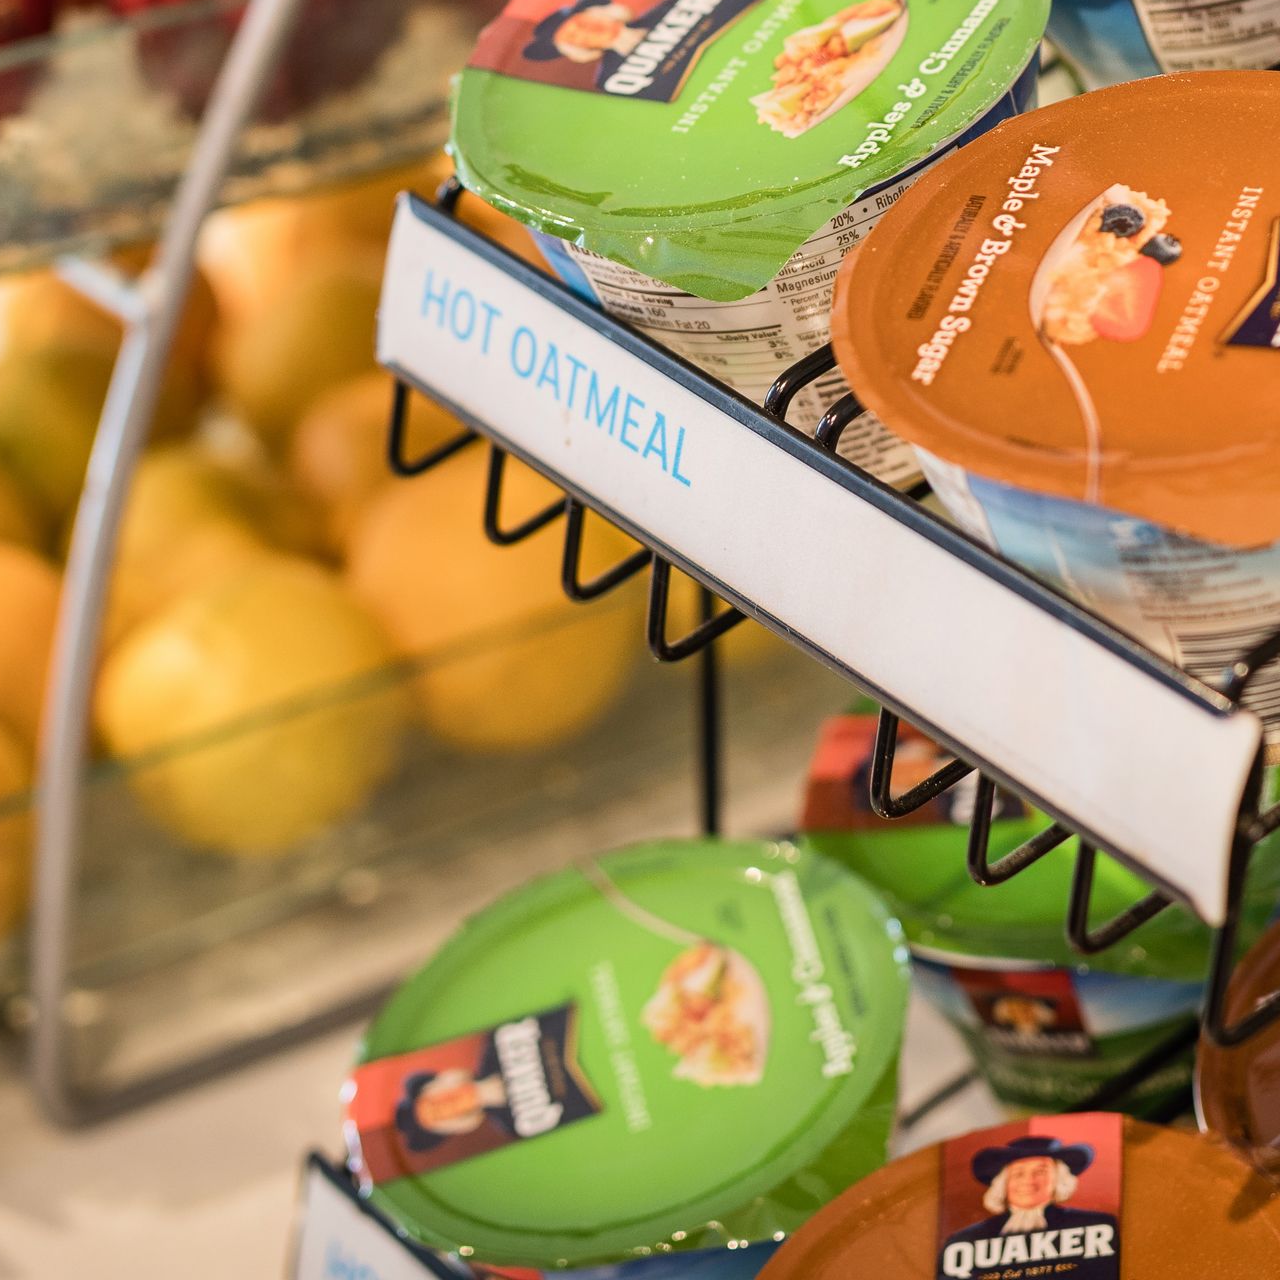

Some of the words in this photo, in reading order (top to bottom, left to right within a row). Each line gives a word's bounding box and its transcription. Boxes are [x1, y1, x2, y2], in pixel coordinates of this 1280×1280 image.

[672, 56, 748, 134] INSTANT
[837, 101, 912, 168] Apples
[898, 77, 927, 99] &
[830, 210, 855, 230] 20%
[875, 177, 920, 210] Ribofl
[1003, 143, 1061, 213] Maple
[836, 228, 860, 247] 25%
[992, 213, 1027, 237] &
[1207, 185, 1265, 272] INSTANT
[776, 269, 839, 294] Magnesium
[948, 238, 1013, 313] Brown
[646, 306, 666, 318] 160
[674, 318, 693, 330] Fat
[694, 319, 711, 331] 20
[1156, 275, 1220, 374] OATMEAL
[420, 269, 502, 356] HOT
[510, 325, 692, 488] OATMEAL
[911, 314, 972, 386] Sugar
[495, 1017, 564, 1137] QUAKER
[943, 1223, 1115, 1279] QUAKER
